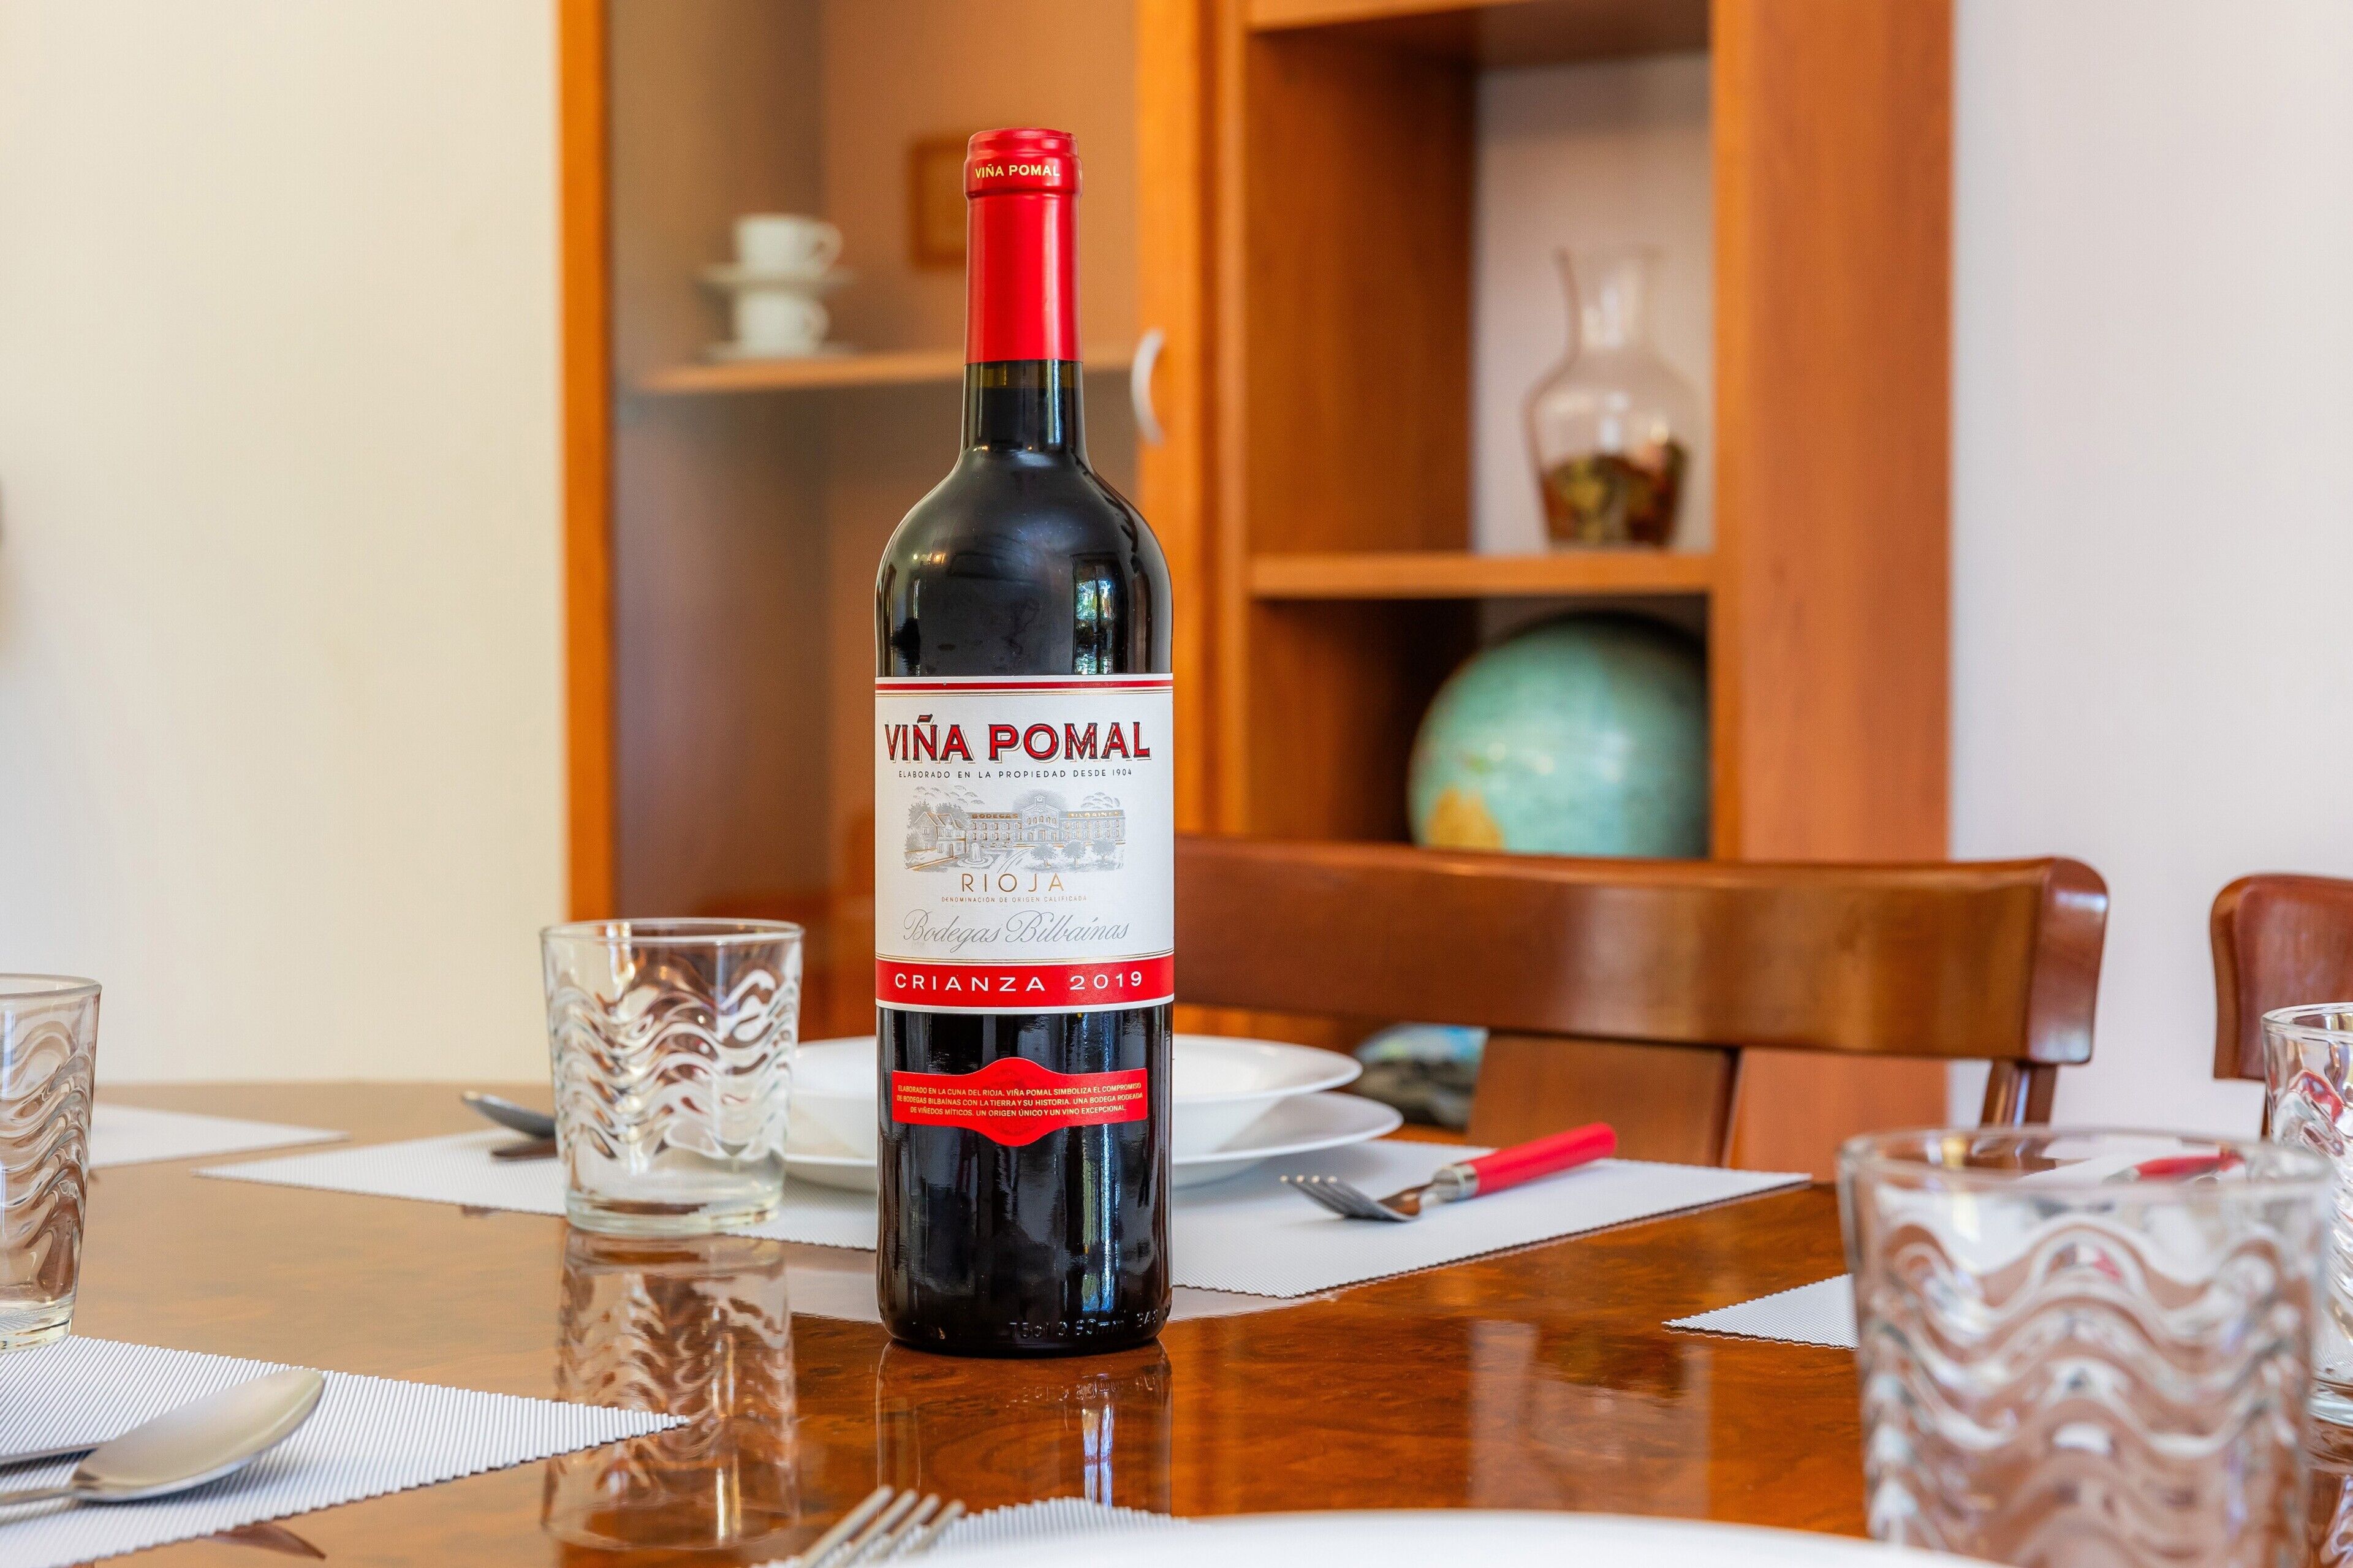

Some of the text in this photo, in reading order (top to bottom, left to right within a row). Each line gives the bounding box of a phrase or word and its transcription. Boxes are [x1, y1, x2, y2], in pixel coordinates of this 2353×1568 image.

[975, 164, 1061, 178] VIÑA POMAL
[884, 714, 1152, 763] VIÑA POMAL
[898, 770, 950, 779] ELABORADO
[1073, 769, 1107, 778] DESDE
[961, 873, 1064, 893] RIOJA
[903, 909, 1131, 953] Bodegas Bilbaínas
[895, 971, 1143, 992] CRIANZA 2019
[898, 1085, 928, 1094] ELABORADO
[1053, 1086, 1091, 1096] SIMBOLIZA
[1102, 1082, 1142, 1093] COMPROMISO
[903, 1096, 927, 1104] BODEGAS
[928, 1097, 961, 1106] BILBAÍNAS
[1117, 1093, 1143, 1102] RODEADA
[917, 1106, 944, 1115] VIÑEDOS
[944, 1108, 974, 1116] MÍTICOS.
